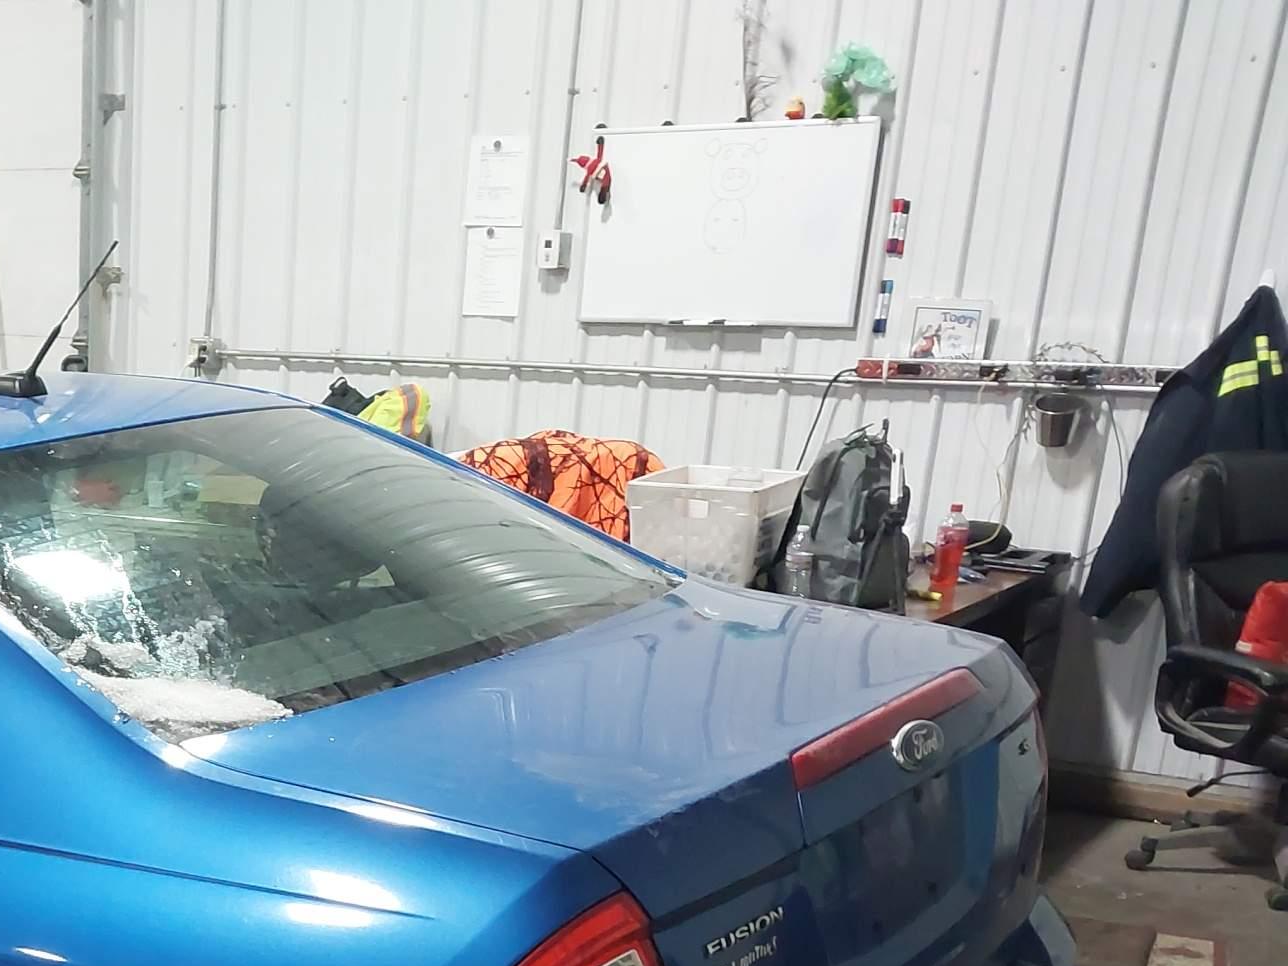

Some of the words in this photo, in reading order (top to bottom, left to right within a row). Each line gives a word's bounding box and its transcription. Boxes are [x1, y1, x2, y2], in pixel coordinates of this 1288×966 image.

[941, 311, 977, 329] TOOT
[913, 727, 938, 761] Ford
[706, 905, 784, 955] FUSION
